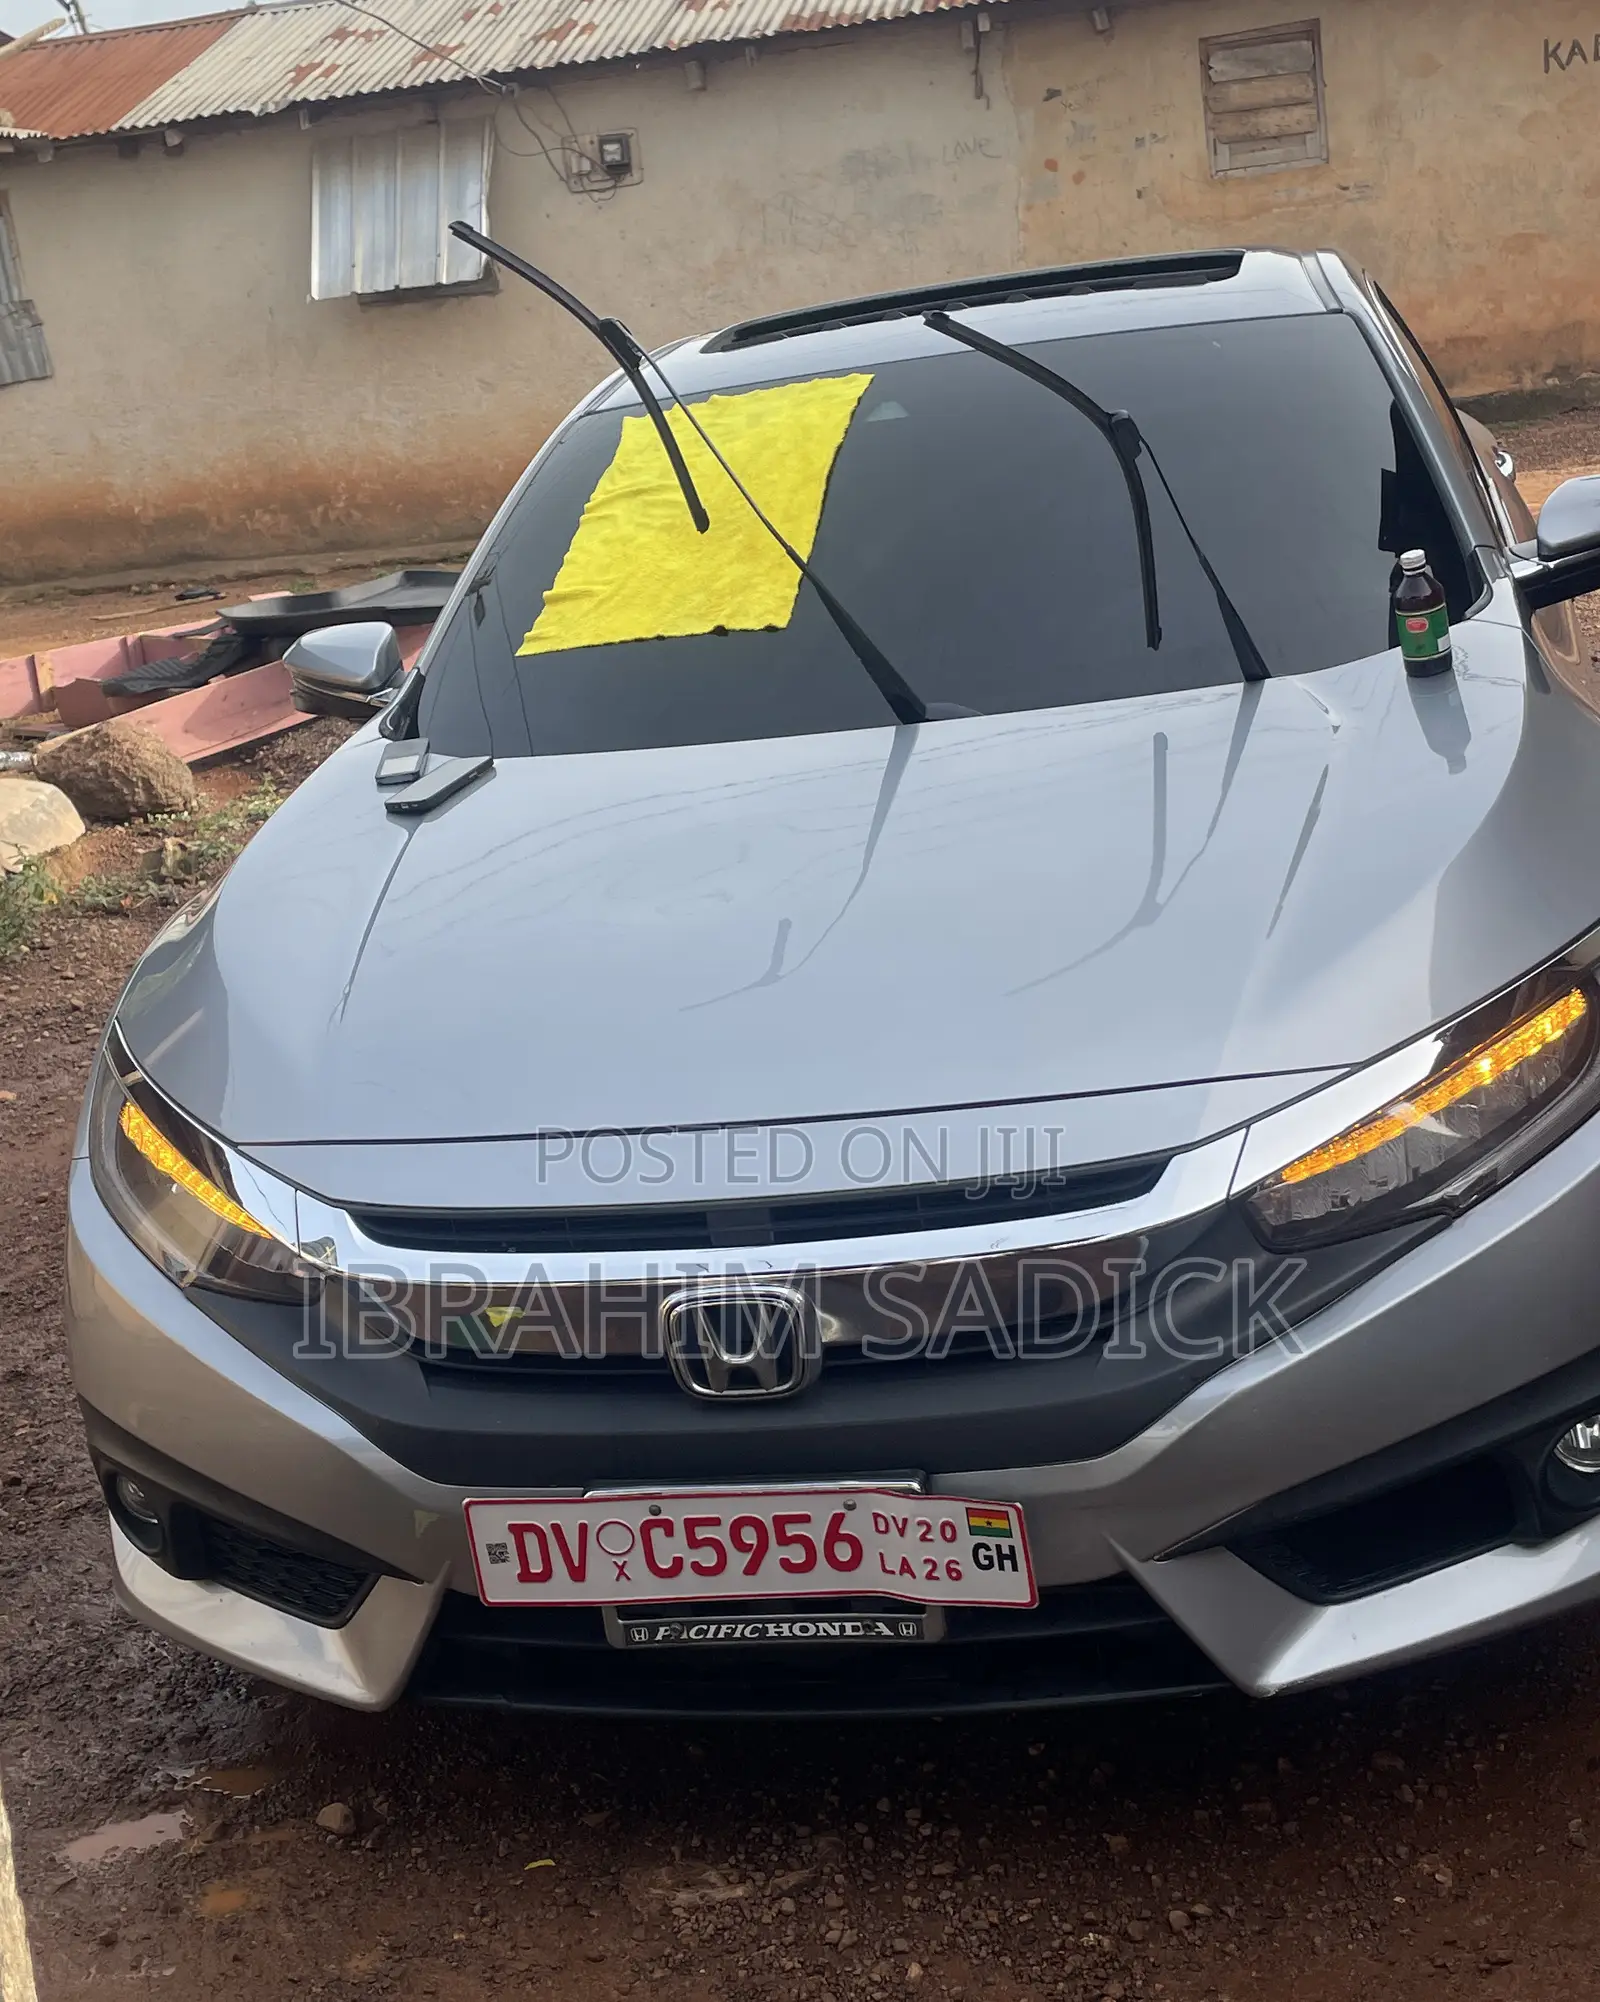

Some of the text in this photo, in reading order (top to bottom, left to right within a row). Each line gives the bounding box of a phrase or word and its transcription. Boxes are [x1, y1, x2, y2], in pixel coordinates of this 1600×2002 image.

[507, 1512, 864, 1584] DV C5956
[972, 1542, 1019, 1573] GH
